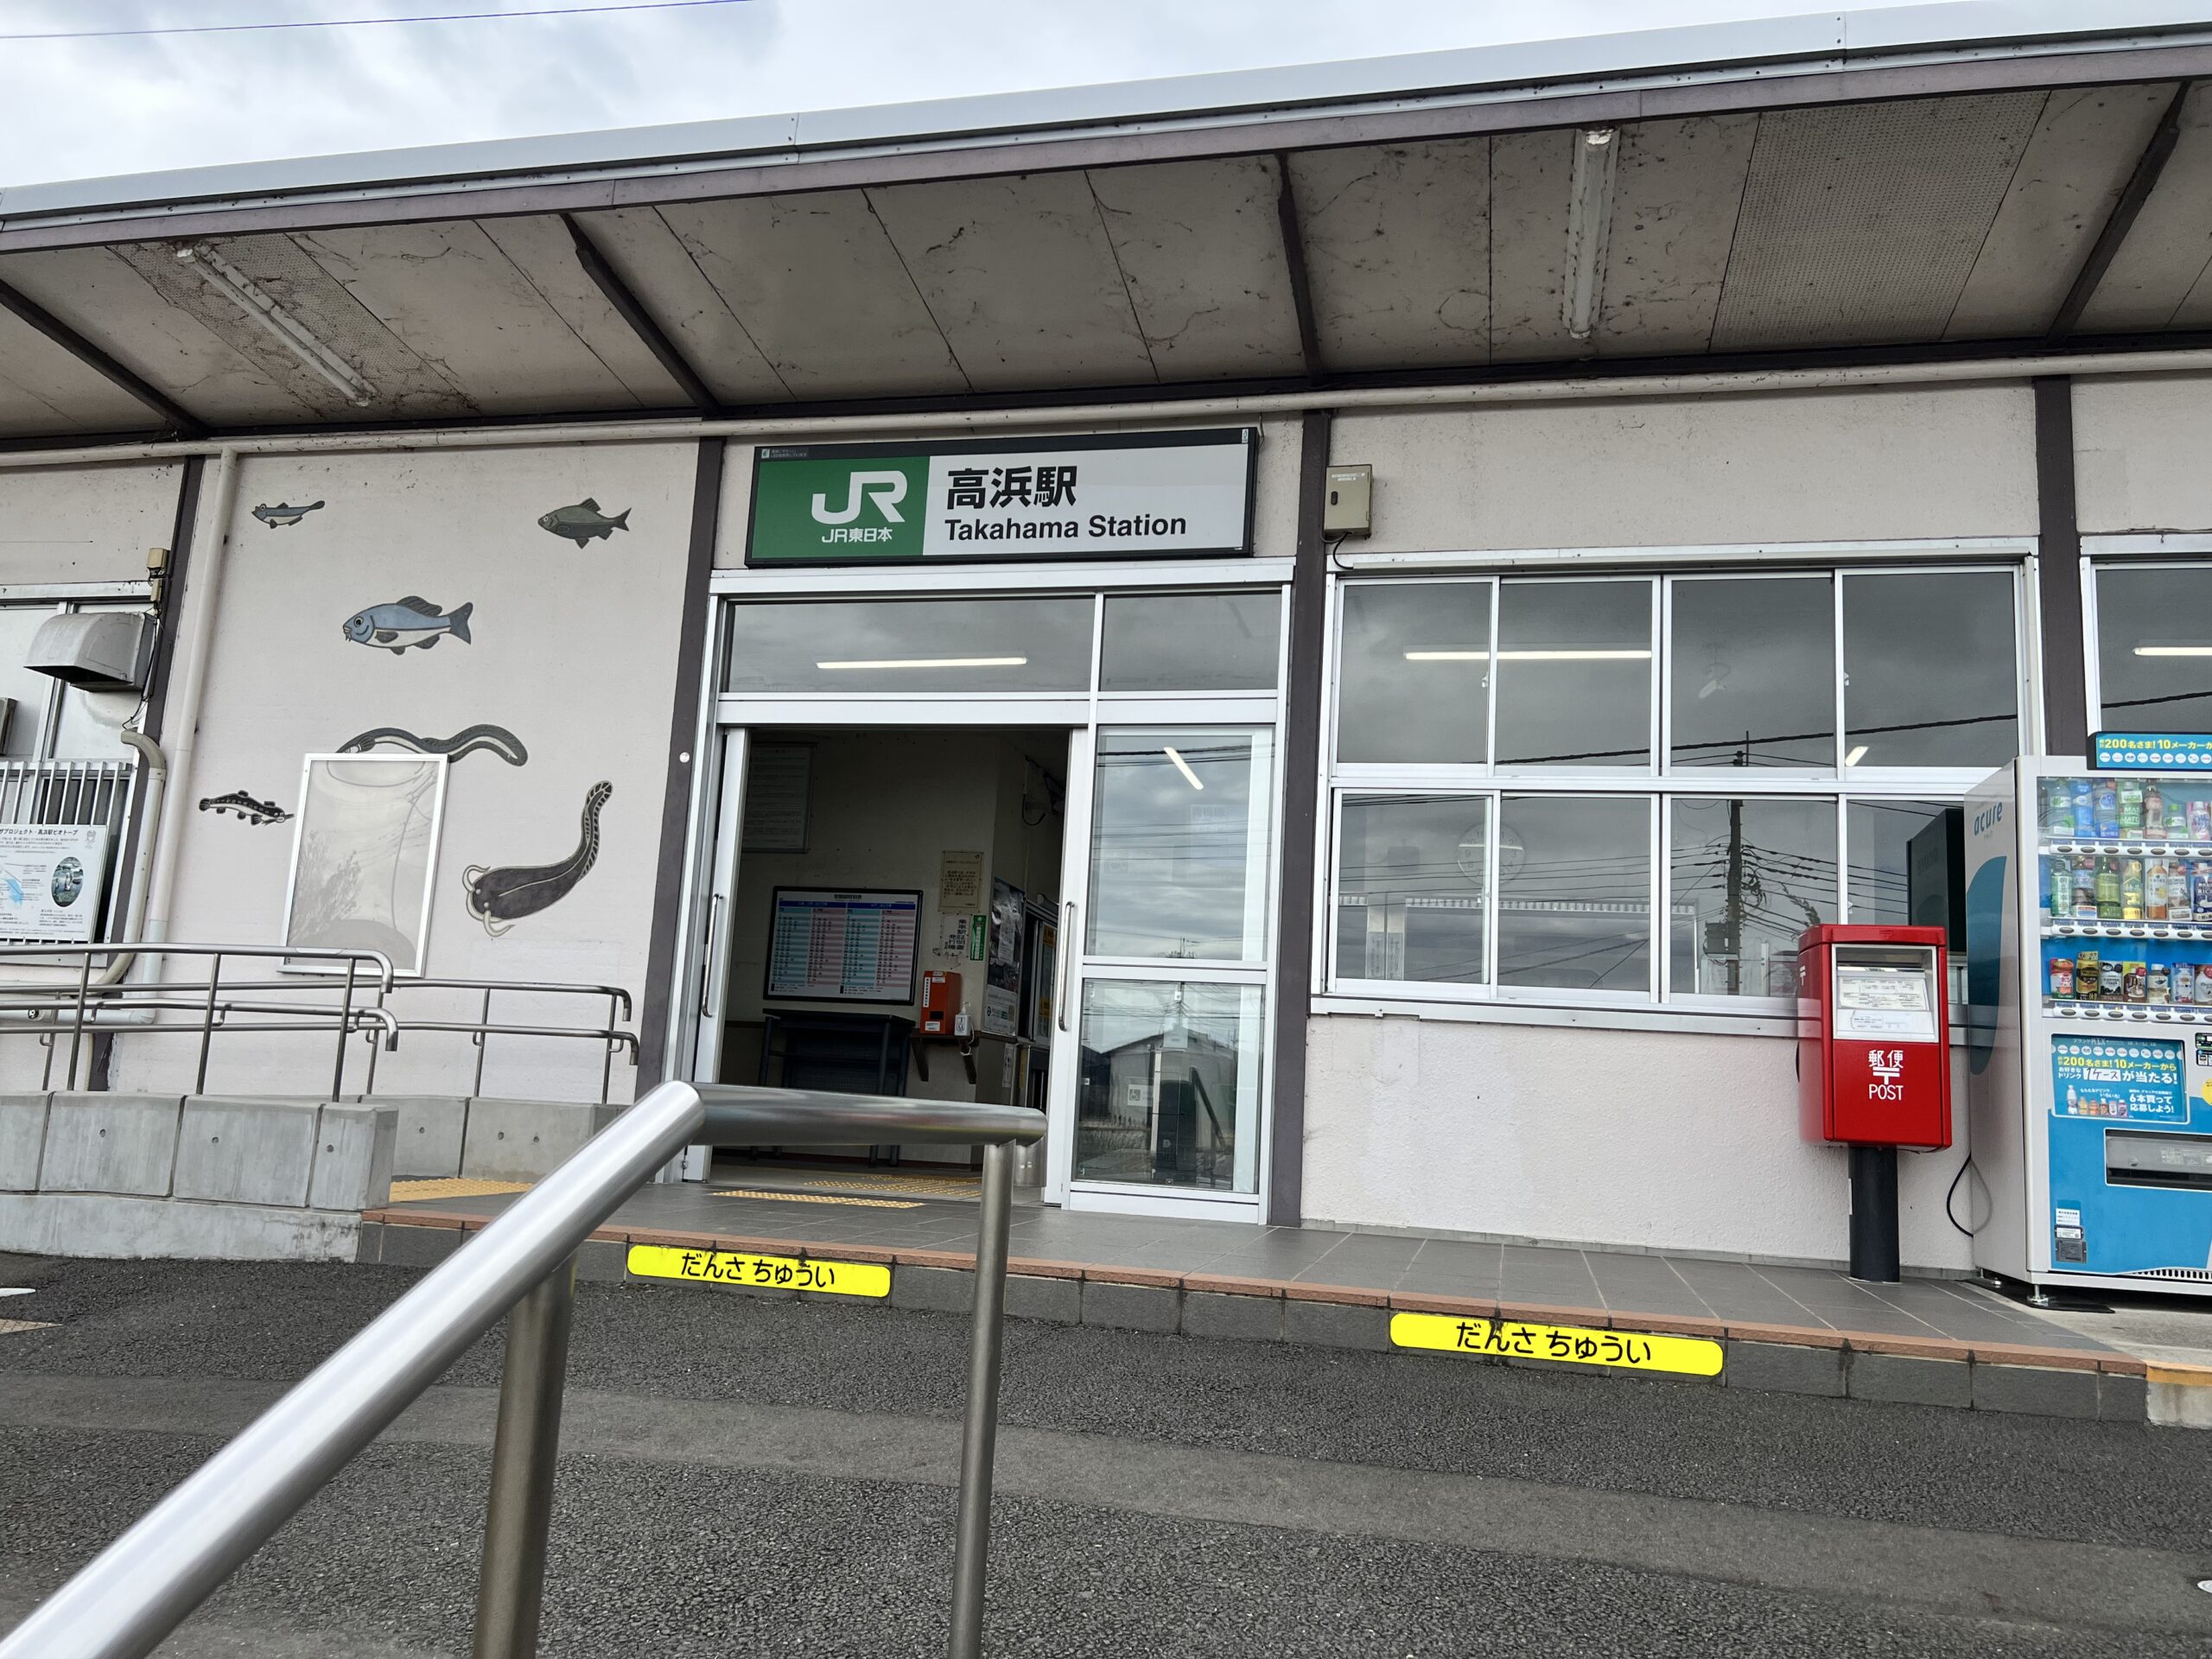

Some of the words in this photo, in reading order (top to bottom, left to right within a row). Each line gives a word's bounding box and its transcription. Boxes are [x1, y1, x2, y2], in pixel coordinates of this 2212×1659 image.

[810, 470, 908, 524] JR
[946, 466, 1078, 510] 高浜駅
[821, 526, 893, 543] JR東日本
[944, 518, 1079, 542] Takahama
[1088, 513, 1187, 539] Station
[1974, 801, 2003, 836] acure
[1868, 1049, 1904, 1069] 郵便
[1868, 1084, 1904, 1101] POST
[2129, 1094, 2173, 1104] 6本買って
